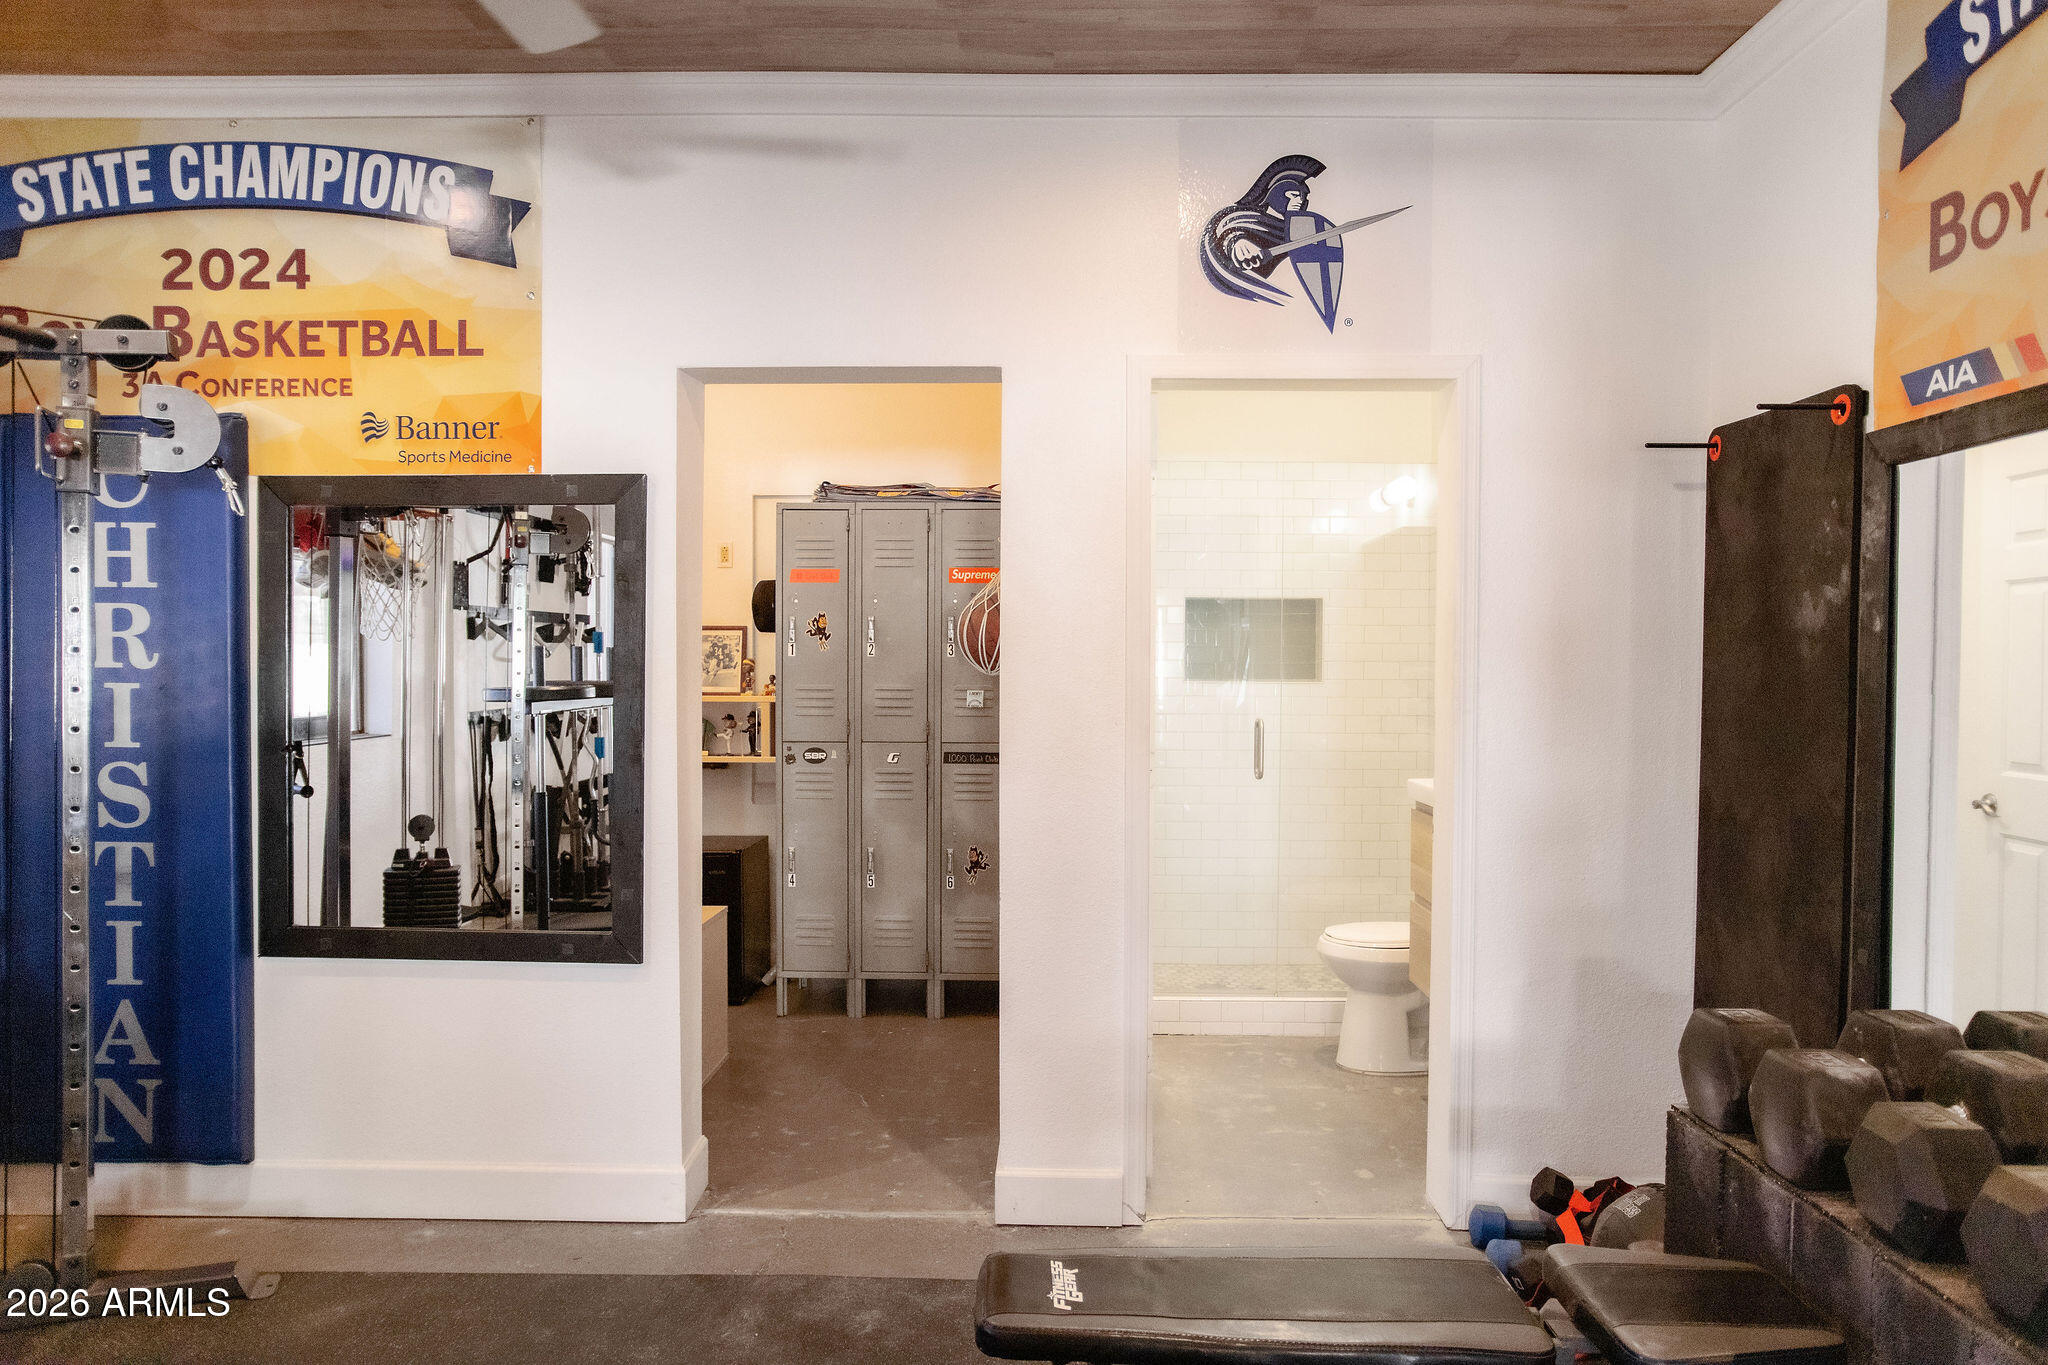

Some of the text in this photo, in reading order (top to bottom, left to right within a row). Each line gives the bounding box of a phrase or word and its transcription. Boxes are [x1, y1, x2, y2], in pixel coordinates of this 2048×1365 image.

[11, 143, 457, 223] STATE CHAMPIONS
[1929, 167, 2048, 273] BOY
[160, 247, 311, 291] 2024
[152, 304, 485, 358] BASKETBALL
[175, 369, 354, 398] CONFERENCE
[1925, 359, 1977, 398] AIA
[395, 415, 500, 440] Banner
[398, 450, 512, 466] Sports Medicine
[951, 568, 997, 582] Supreme
[868, 643, 875, 656] 2
[948, 643, 954, 656] 3
[804, 752, 827, 760] SBR
[789, 874, 795, 886] 4
[867, 875, 874, 887] 5
[946, 876, 953, 889] 6
[1048, 1260, 1072, 1311] FITNESS
[1063, 1268, 1084, 1303] GEAR
